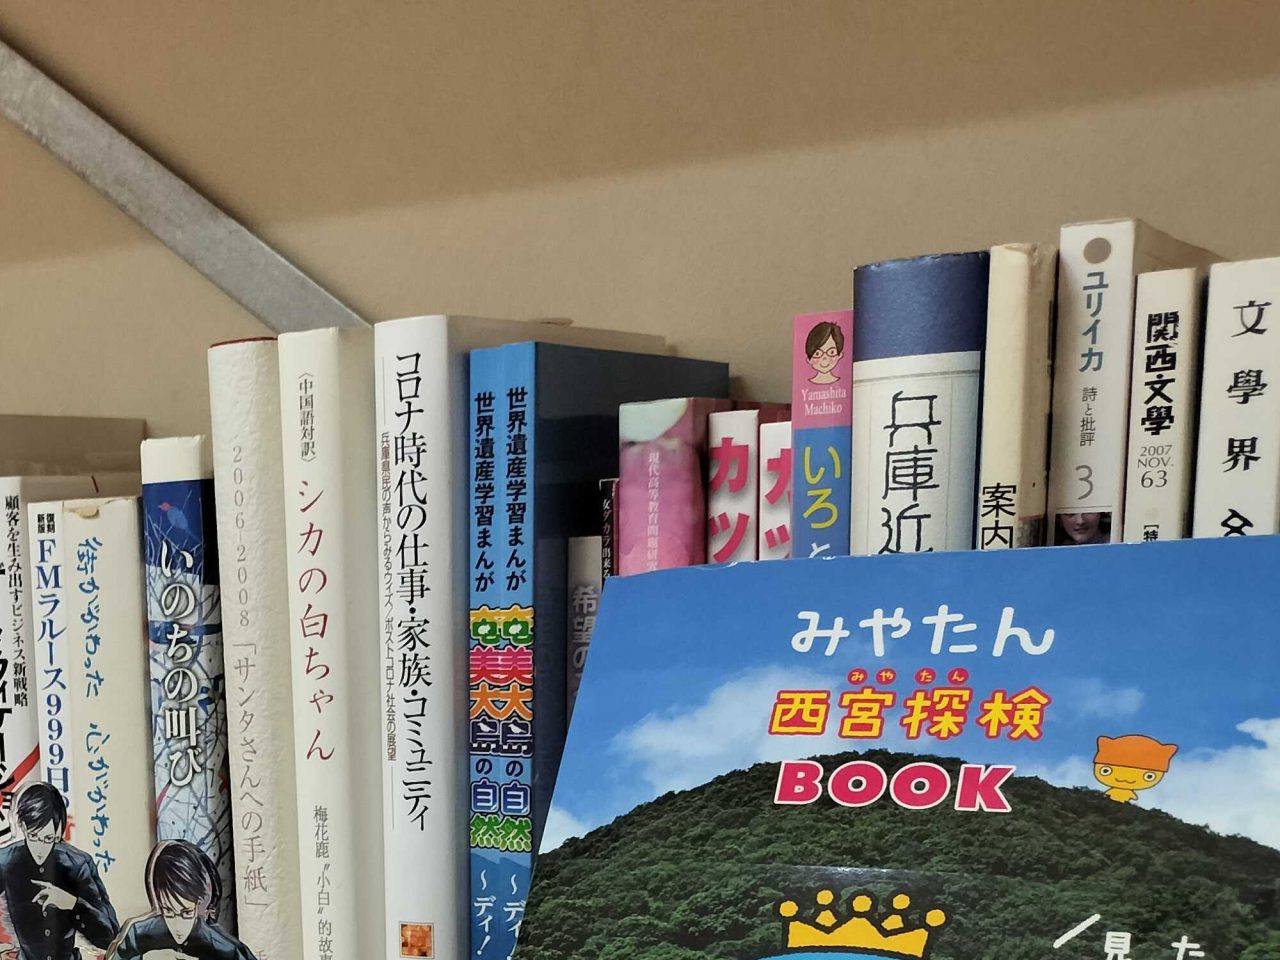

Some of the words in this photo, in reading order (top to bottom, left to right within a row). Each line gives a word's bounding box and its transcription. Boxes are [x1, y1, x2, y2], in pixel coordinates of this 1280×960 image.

[1078, 270, 1108, 372] ユリイカ
[801, 388, 847, 401] Yamashita
[1141, 311, 1179, 436] 関西文學
[1222, 300, 1272, 472] 文學界
[804, 403, 842, 415] Machiko
[1080, 386, 1098, 447] 詩と批評
[1075, 465, 1094, 500] 3
[1137, 456, 1173, 469] NOV.
[1140, 445, 1172, 457] 2007
[1140, 470, 1168, 488] 63
[473, 391, 495, 592] 世界遺産学習まんが
[506, 386, 528, 592] 世界遺産学習まんが
[980, 484, 1016, 549] 案内
[5, 495, 28, 707] 顧客を生み出すビジネス新戦略
[298, 480, 336, 762] シカの白ちゃん
[394, 352, 433, 832] コロナ時代の仕事・家族・コミュニティ
[791, 604, 1056, 657] みやたん
[160, 540, 203, 787] いのちの叫び
[850, 668, 968, 685] みやたん
[499, 605, 533, 851] 奄美大島の自然
[769, 686, 1052, 741] 西宮探検
[774, 760, 1017, 813] BOOK
